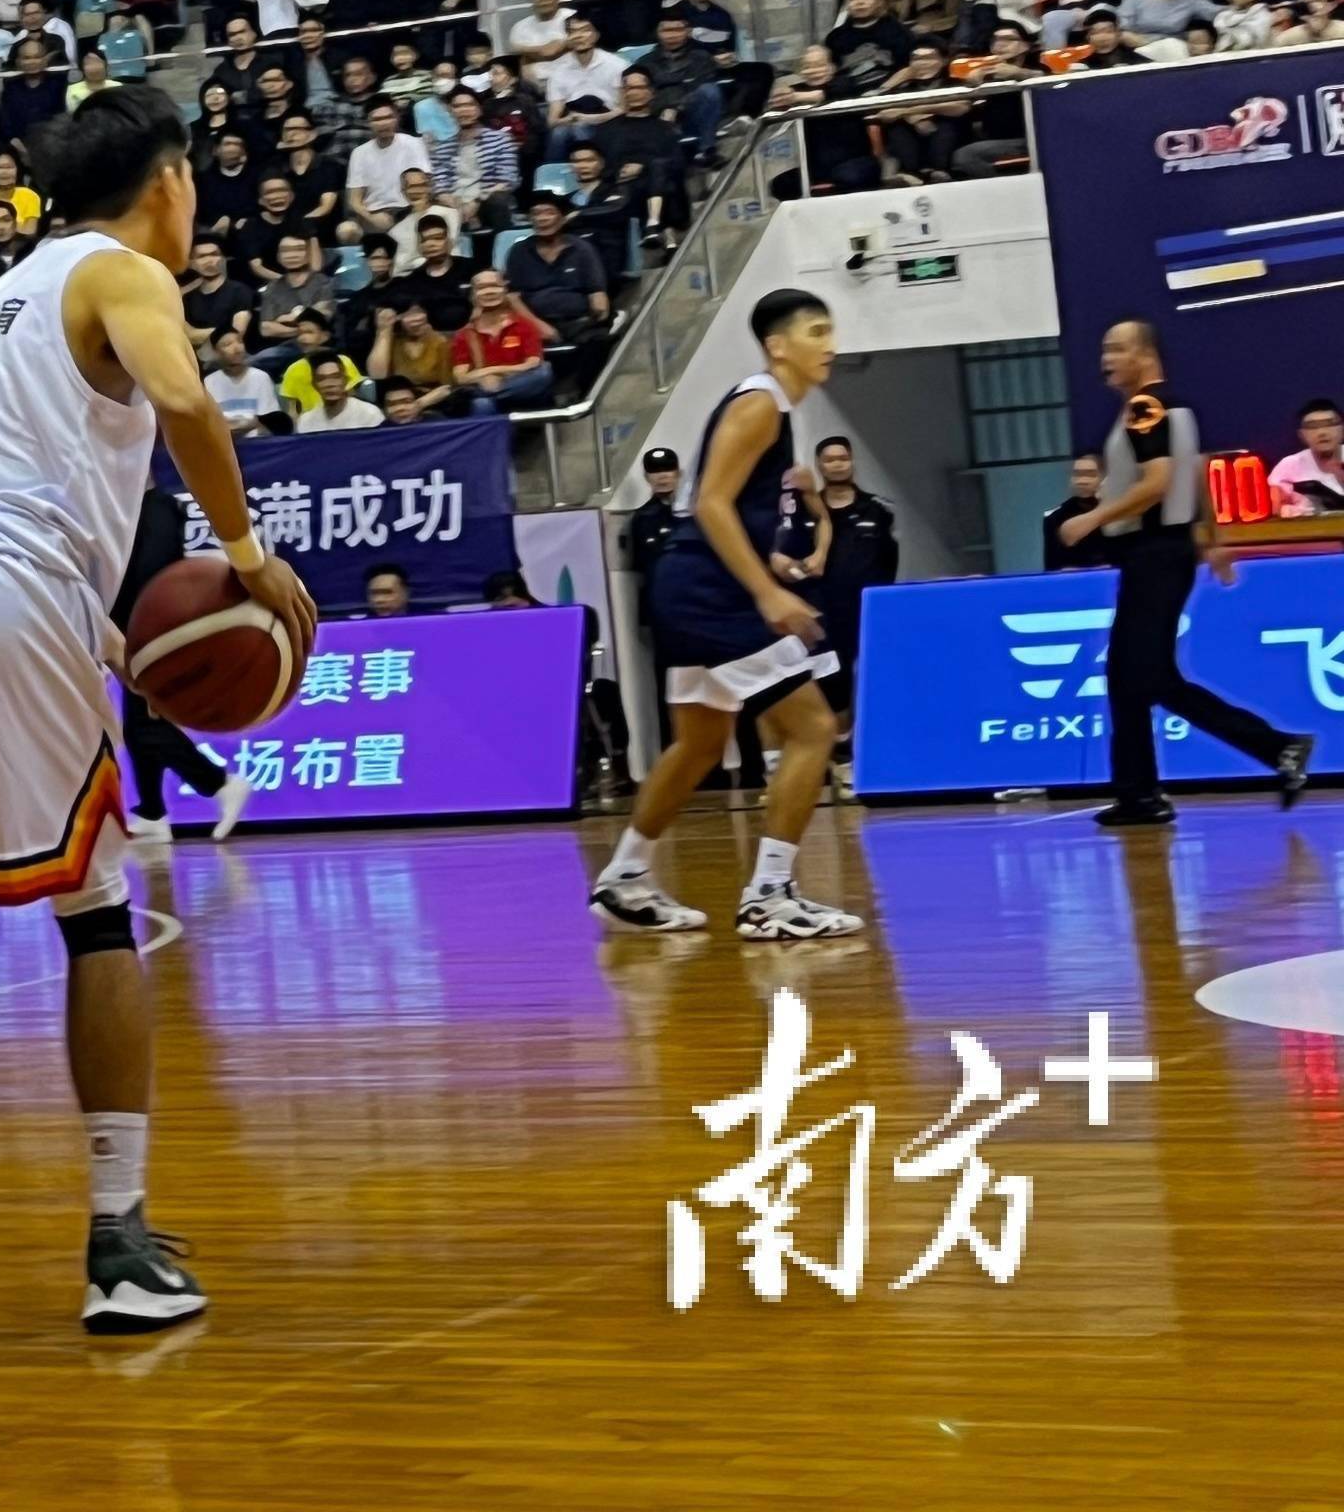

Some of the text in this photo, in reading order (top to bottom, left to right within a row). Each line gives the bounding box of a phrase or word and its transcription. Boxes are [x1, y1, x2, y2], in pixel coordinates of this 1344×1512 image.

[979, 714, 1191, 743] FeiXig
[178, 733, 405, 794] 场布置
